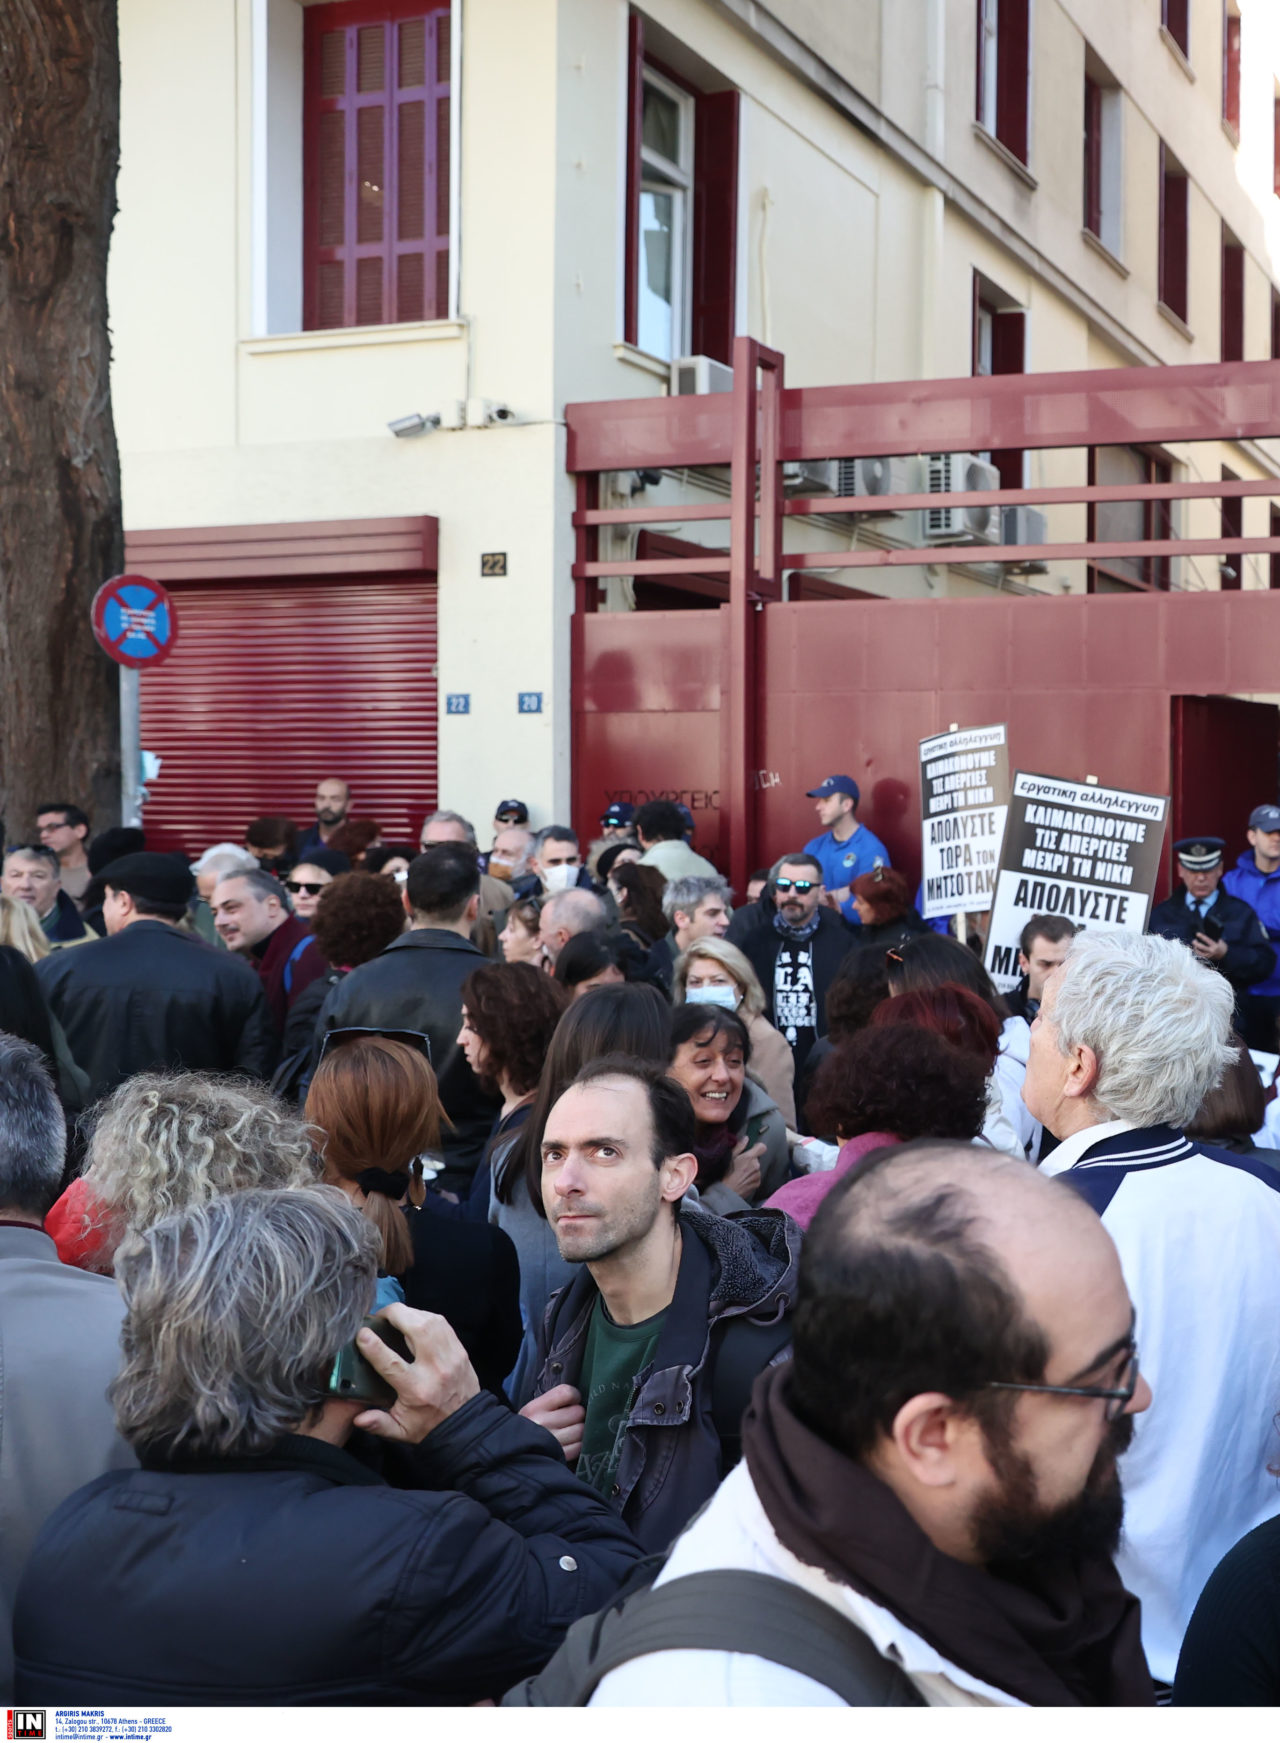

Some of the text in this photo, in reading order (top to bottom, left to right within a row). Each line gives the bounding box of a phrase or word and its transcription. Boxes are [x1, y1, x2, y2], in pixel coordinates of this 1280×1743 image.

[482, 553, 505, 574] 22
[450, 696, 466, 713] 22
[522, 694, 538, 711] 20
[1020, 780, 1160, 817] εργατικη αλληλεγγυη
[930, 812, 996, 845] ΑΠΟΛΥΣΤΕ
[1024, 803, 1146, 843] ΚΛΙΜΑΚΩΝΟΥΜΕ
[939, 843, 996, 871] ΤΩΡΑ ΤΟΝ
[1035, 828, 1130, 862] ΤΙΣ ΑΠΕΡΓΙΕΣ
[1022, 848, 1134, 886] ΜΕΧΡΙ ΤΗ ΝΙΚΗ
[927, 869, 997, 901] ΜΗΤΣΟΤΑΚ
[1013, 878, 1130, 924] ΑΠΟΛΥΣΤΕ
